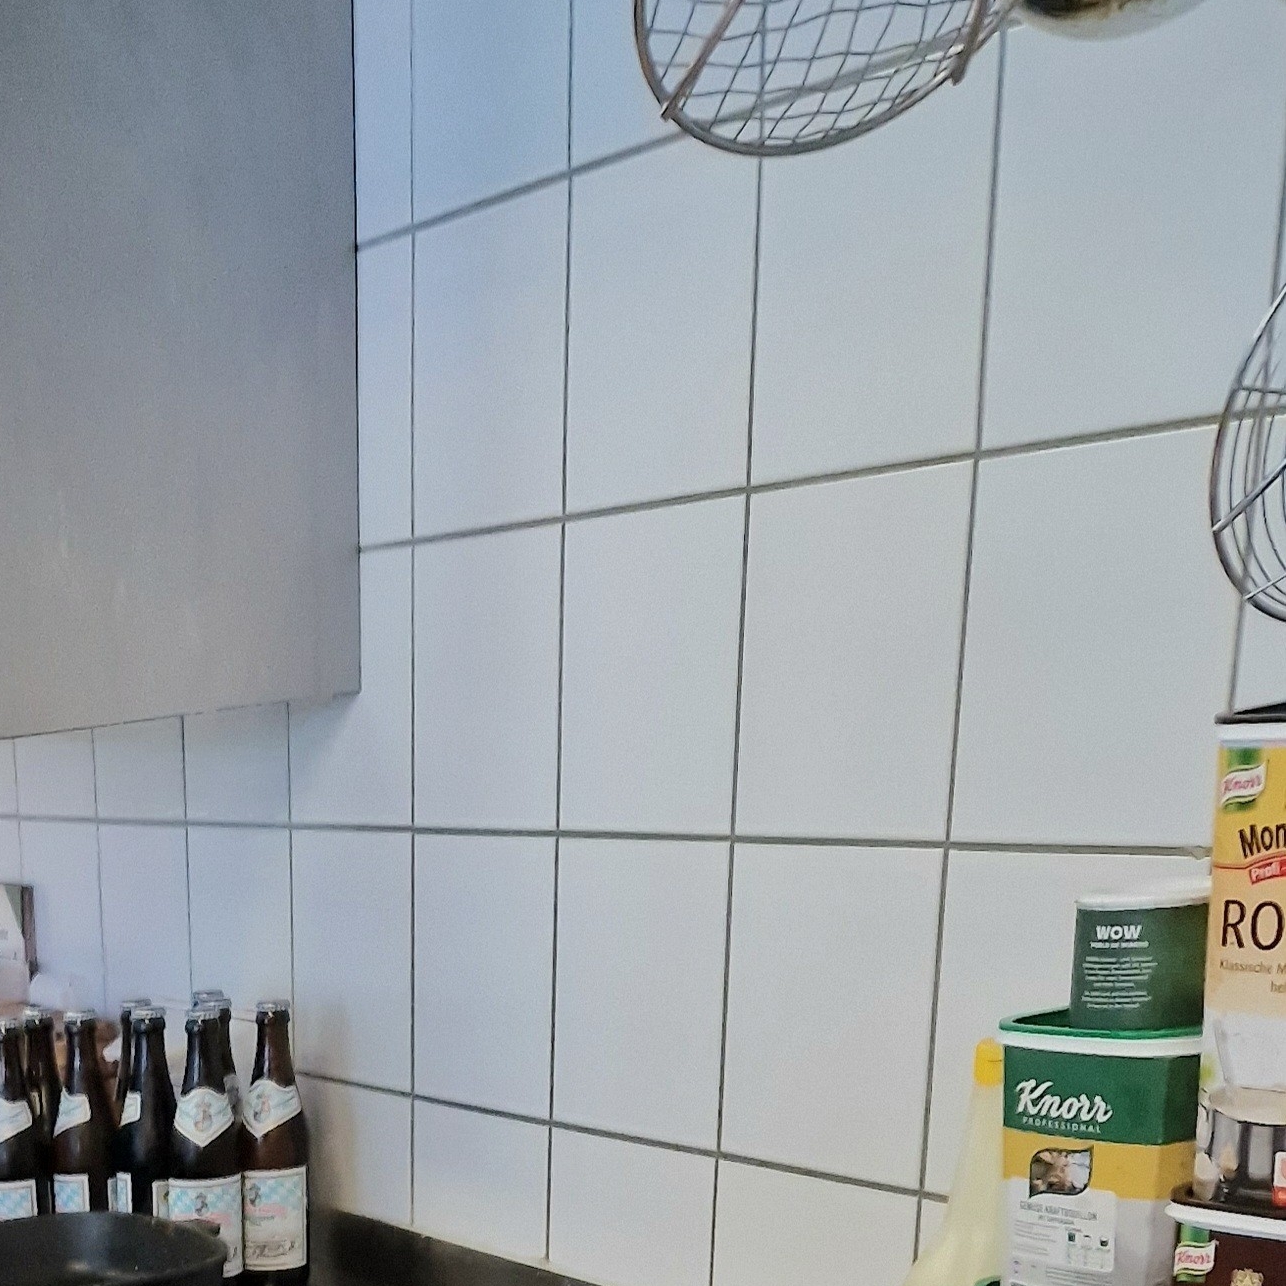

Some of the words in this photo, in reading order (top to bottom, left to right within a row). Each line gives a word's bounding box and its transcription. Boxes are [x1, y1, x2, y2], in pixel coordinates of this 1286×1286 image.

[1096, 925, 1142, 940] WOW
[1016, 1079, 1113, 1123] Knorr
[1023, 1116, 1101, 1133] PROFESSIONAL
[1177, 1250, 1212, 1265] Knorr
